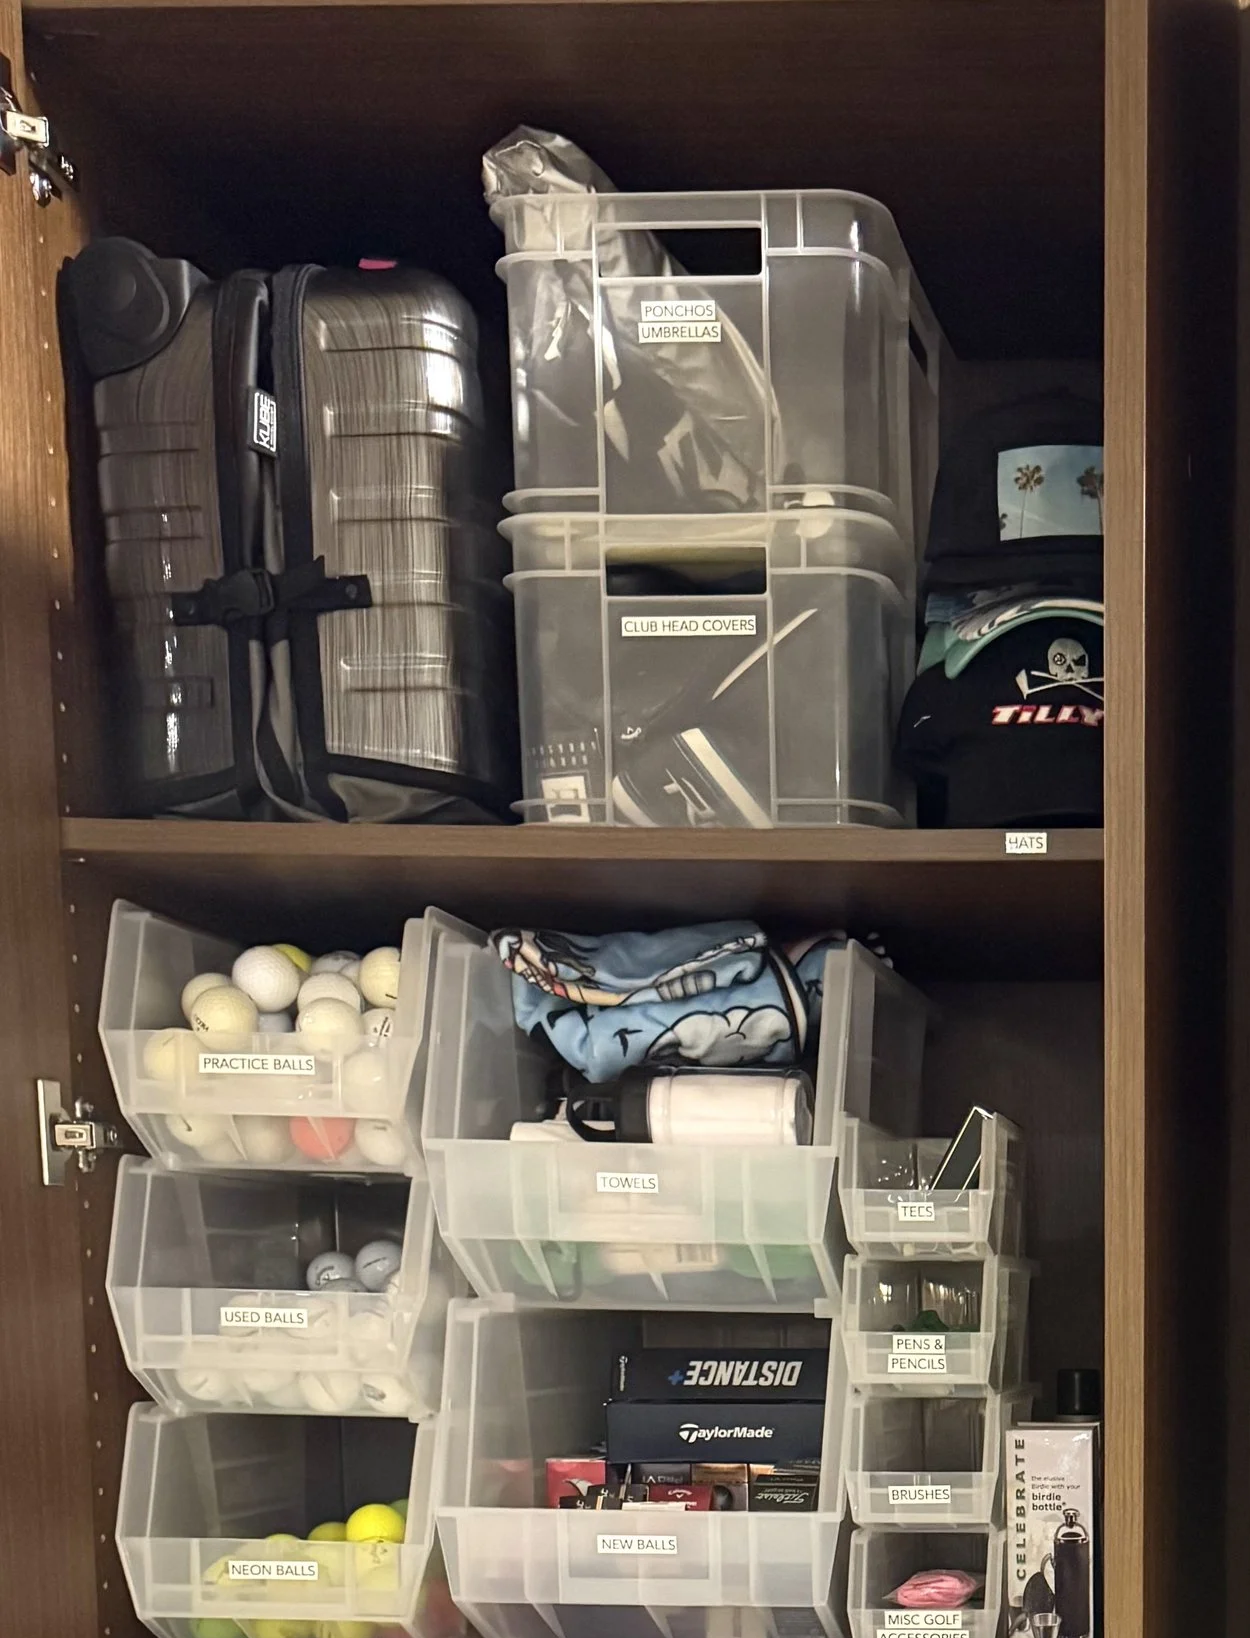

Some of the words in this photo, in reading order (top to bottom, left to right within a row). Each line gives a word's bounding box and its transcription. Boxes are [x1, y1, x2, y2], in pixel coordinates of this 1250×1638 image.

[644, 304, 714, 318] PONCHOS
[641, 325, 719, 339] UMBRELLAS
[259, 394, 271, 449] KUBE
[624, 620, 658, 633] CLUB
[661, 620, 699, 632] HEAD
[702, 618, 755, 632] COVERS
[1008, 836, 1044, 850] HATS
[203, 1057, 269, 1070] PRACTICE
[273, 1058, 313, 1071] BALLS
[601, 1176, 656, 1190] TOWELS
[224, 1310, 261, 1323] USED
[264, 1311, 305, 1325] BALLS
[896, 1338, 931, 1351] PENS
[933, 1338, 944, 1350] &
[891, 1357, 945, 1370] PENCILS
[679, 1423, 774, 1443] TaylorMade
[891, 1488, 949, 1501] BRUSHES
[1032, 1493, 1062, 1501] birdie
[1015, 1438, 1026, 1581] CELEBRATE
[601, 1538, 633, 1550] NEW
[637, 1539, 675, 1551] BALLS
[231, 1564, 272, 1576] NEON
[276, 1564, 316, 1577] BALLS
[888, 1613, 920, 1626] MISC
[923, 1613, 960, 1626] GOLF
